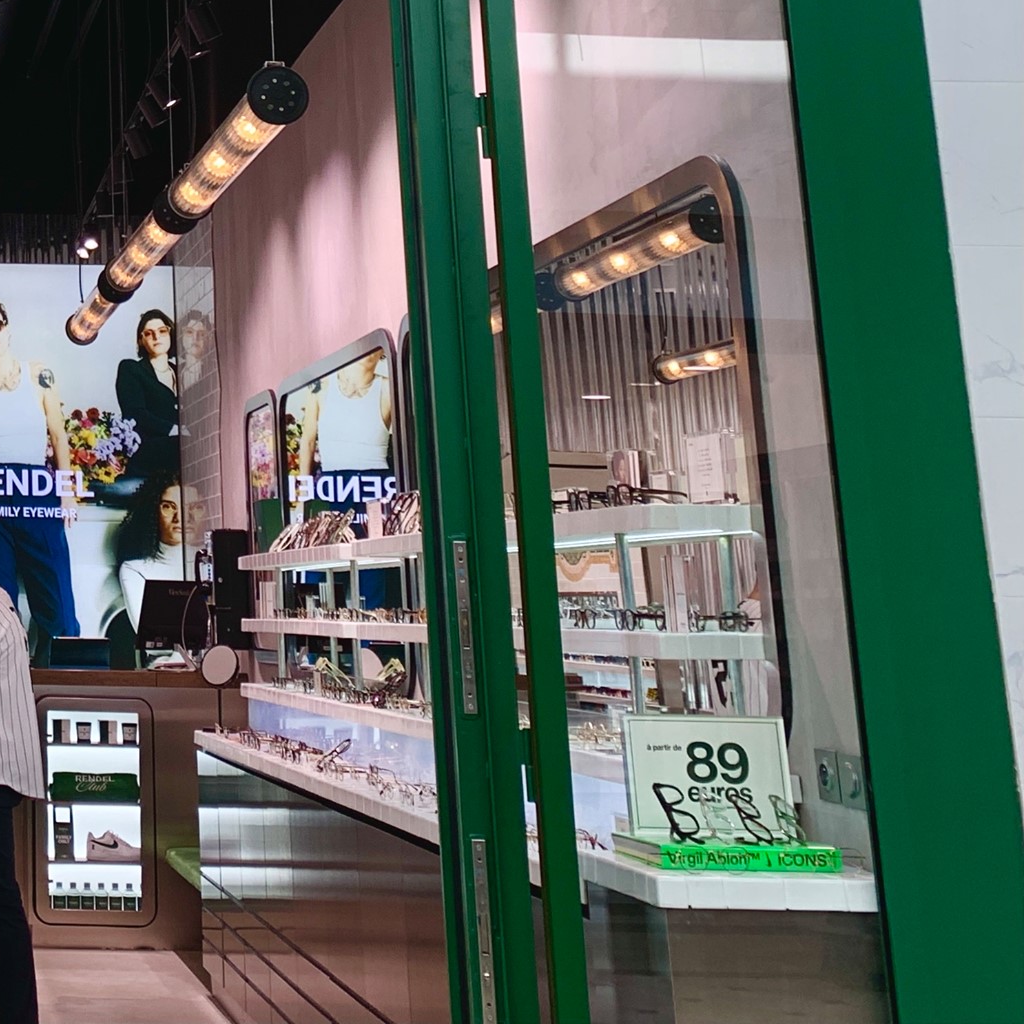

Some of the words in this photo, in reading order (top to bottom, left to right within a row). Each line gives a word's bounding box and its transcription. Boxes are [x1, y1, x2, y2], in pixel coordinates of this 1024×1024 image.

[23, 506, 77, 519] EYEWEAR
[686, 741, 749, 784] 89
[75, 775, 116, 783] RENDEL
[76, 780, 107, 793] Club
